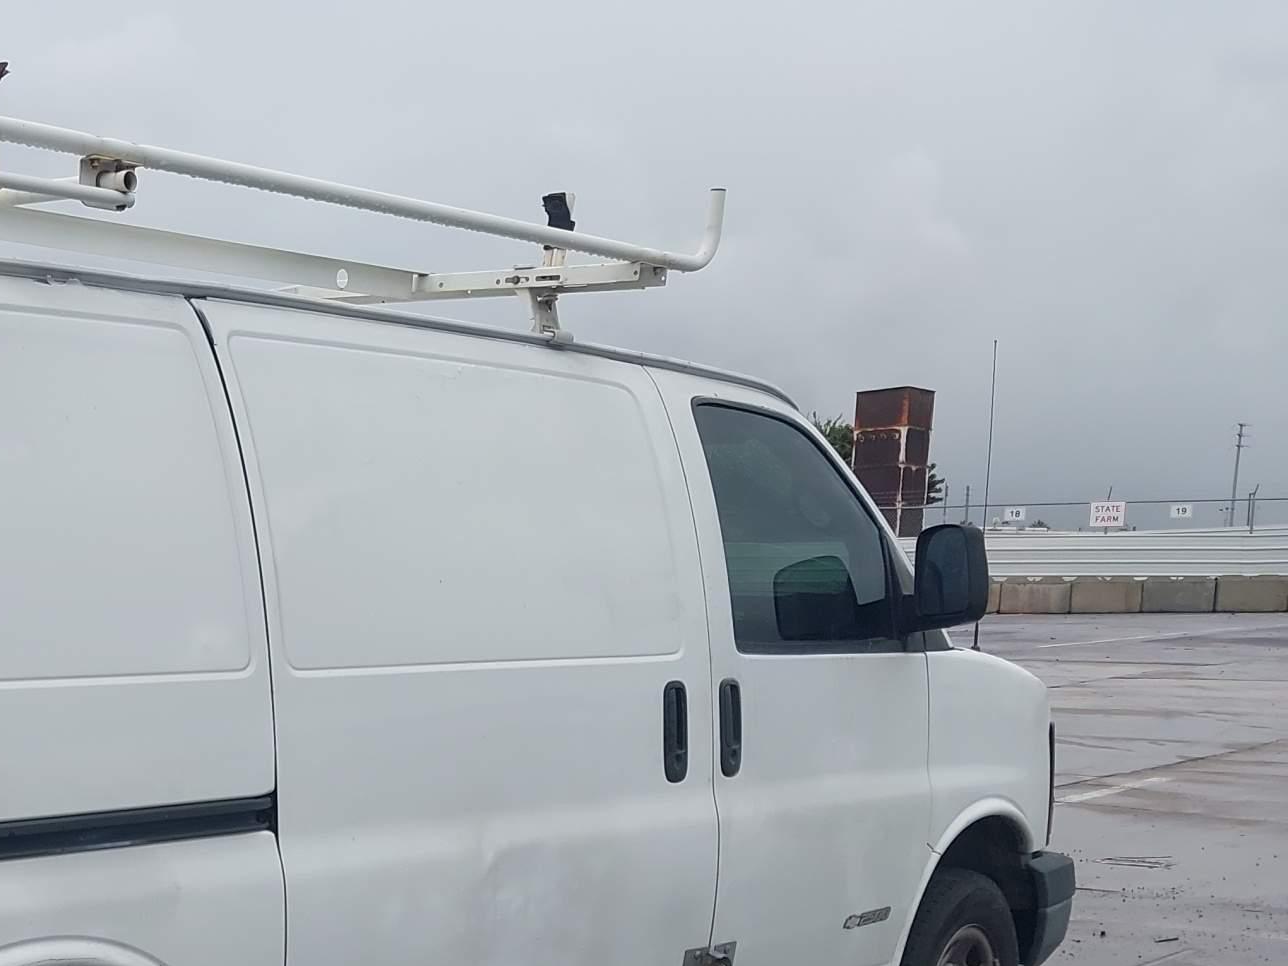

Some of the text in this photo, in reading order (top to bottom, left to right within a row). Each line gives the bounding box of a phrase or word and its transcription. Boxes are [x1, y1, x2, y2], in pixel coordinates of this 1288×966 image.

[1094, 505, 1121, 513] STATE
[1175, 507, 1188, 515] 19
[1009, 510, 1021, 518] 18
[1094, 515, 1120, 523] FARM
